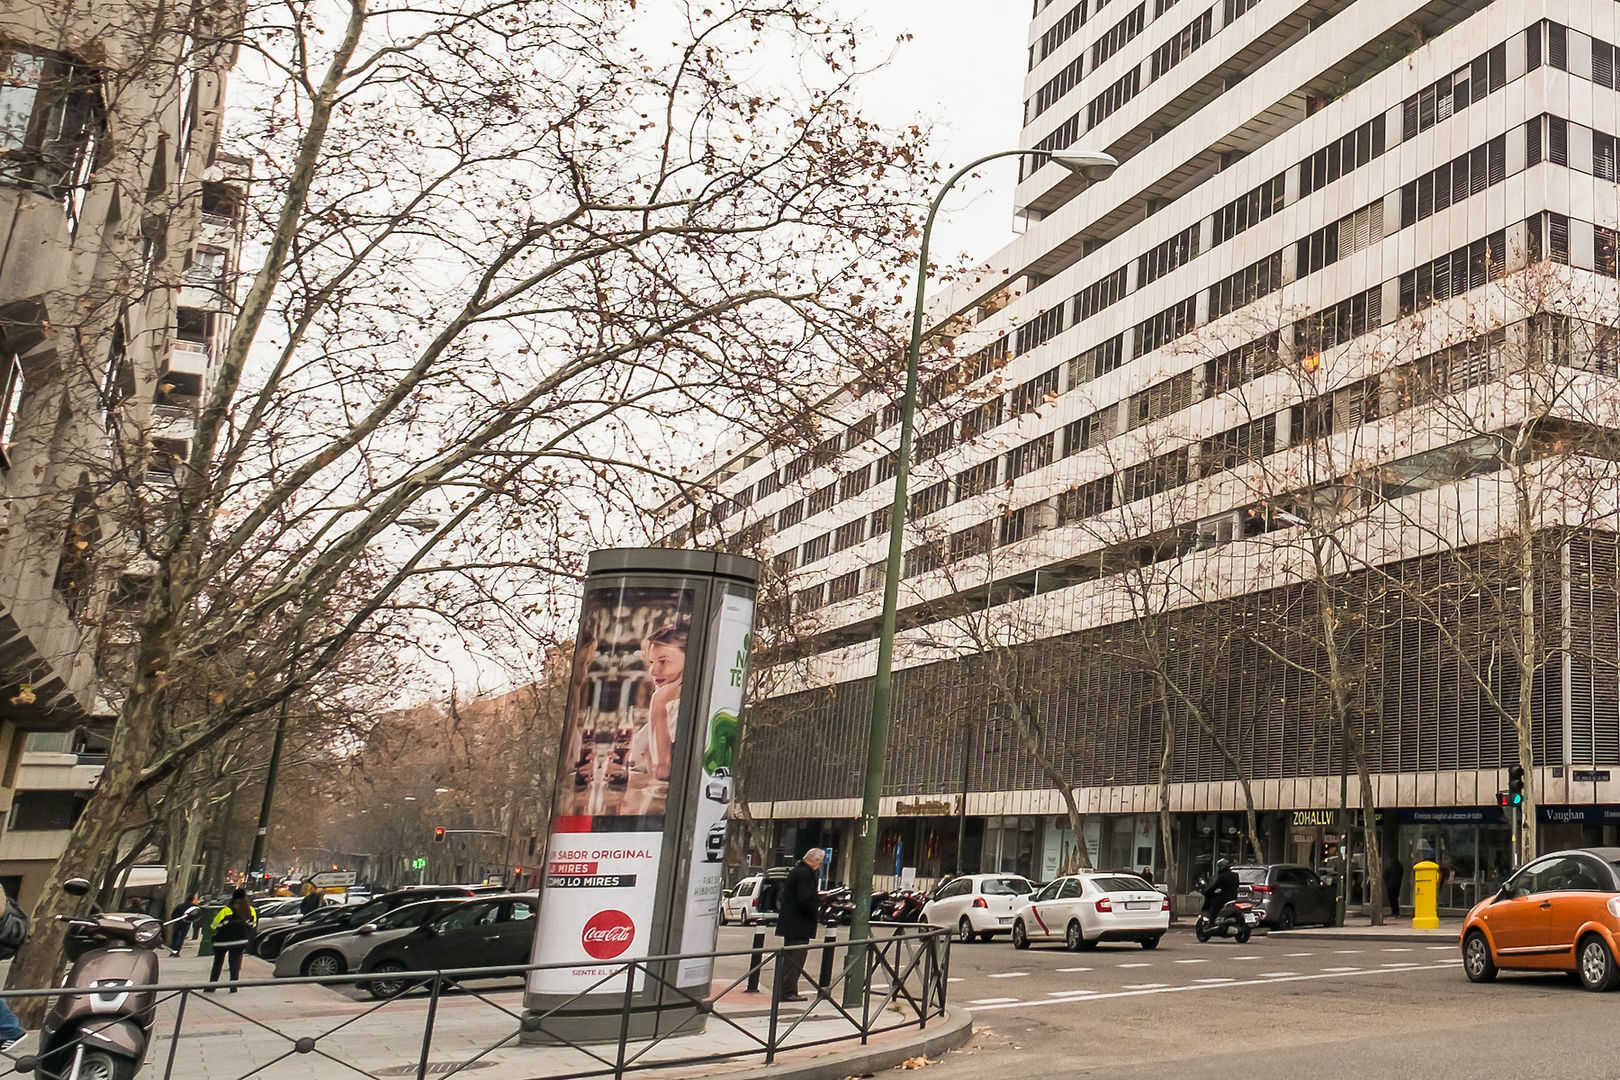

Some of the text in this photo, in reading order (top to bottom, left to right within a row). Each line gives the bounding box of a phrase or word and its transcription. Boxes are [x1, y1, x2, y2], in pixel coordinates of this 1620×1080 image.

[1546, 809, 1585, 822] Vaughan
[558, 850, 588, 860] SABOR
[591, 850, 652, 859] ORIGINAL
[558, 864, 589, 874] MIRES
[567, 877, 580, 887] LO
[583, 877, 620, 887] MIRES
